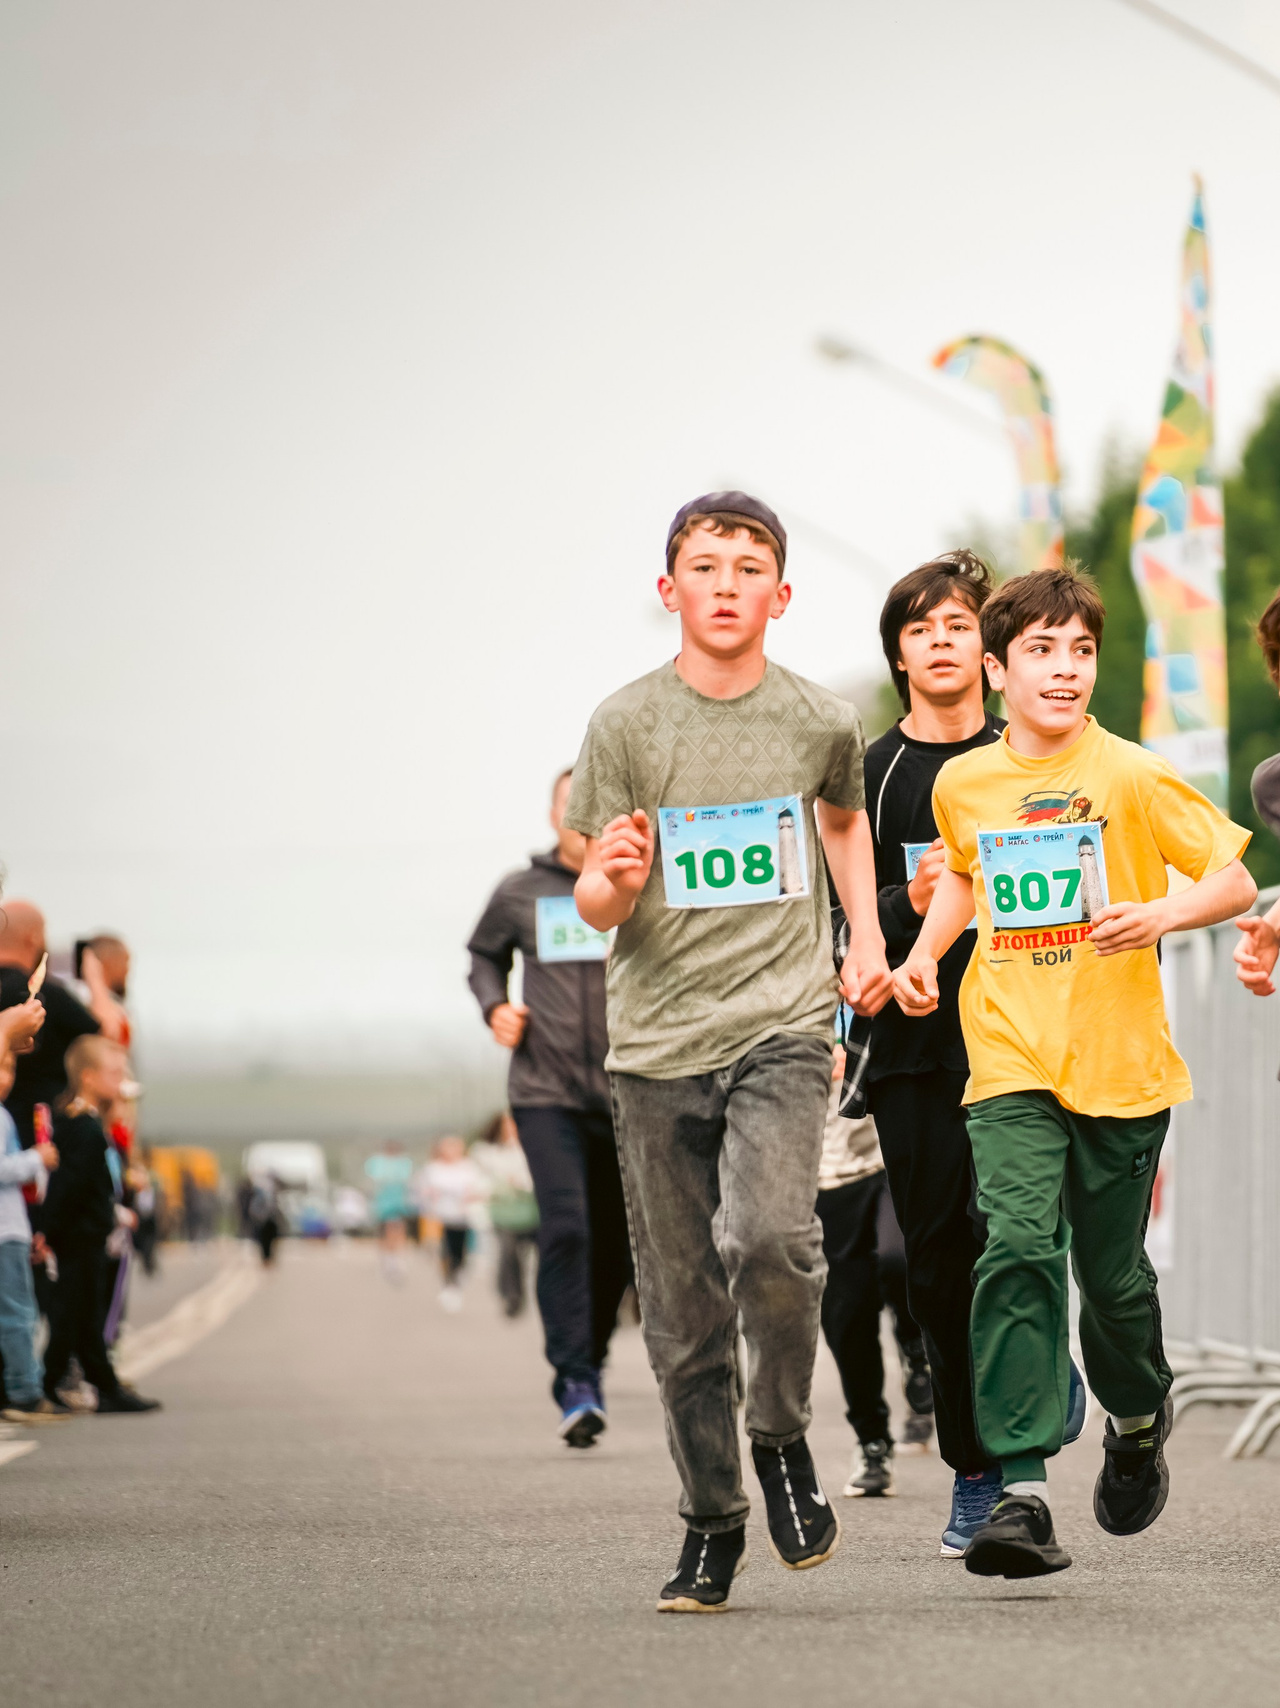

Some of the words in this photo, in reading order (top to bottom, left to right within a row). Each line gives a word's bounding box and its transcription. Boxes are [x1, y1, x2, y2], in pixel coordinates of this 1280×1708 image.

[674, 844, 775, 890] 108
[993, 868, 1082, 913] 807
[1032, 945, 1072, 966] БОЙ
